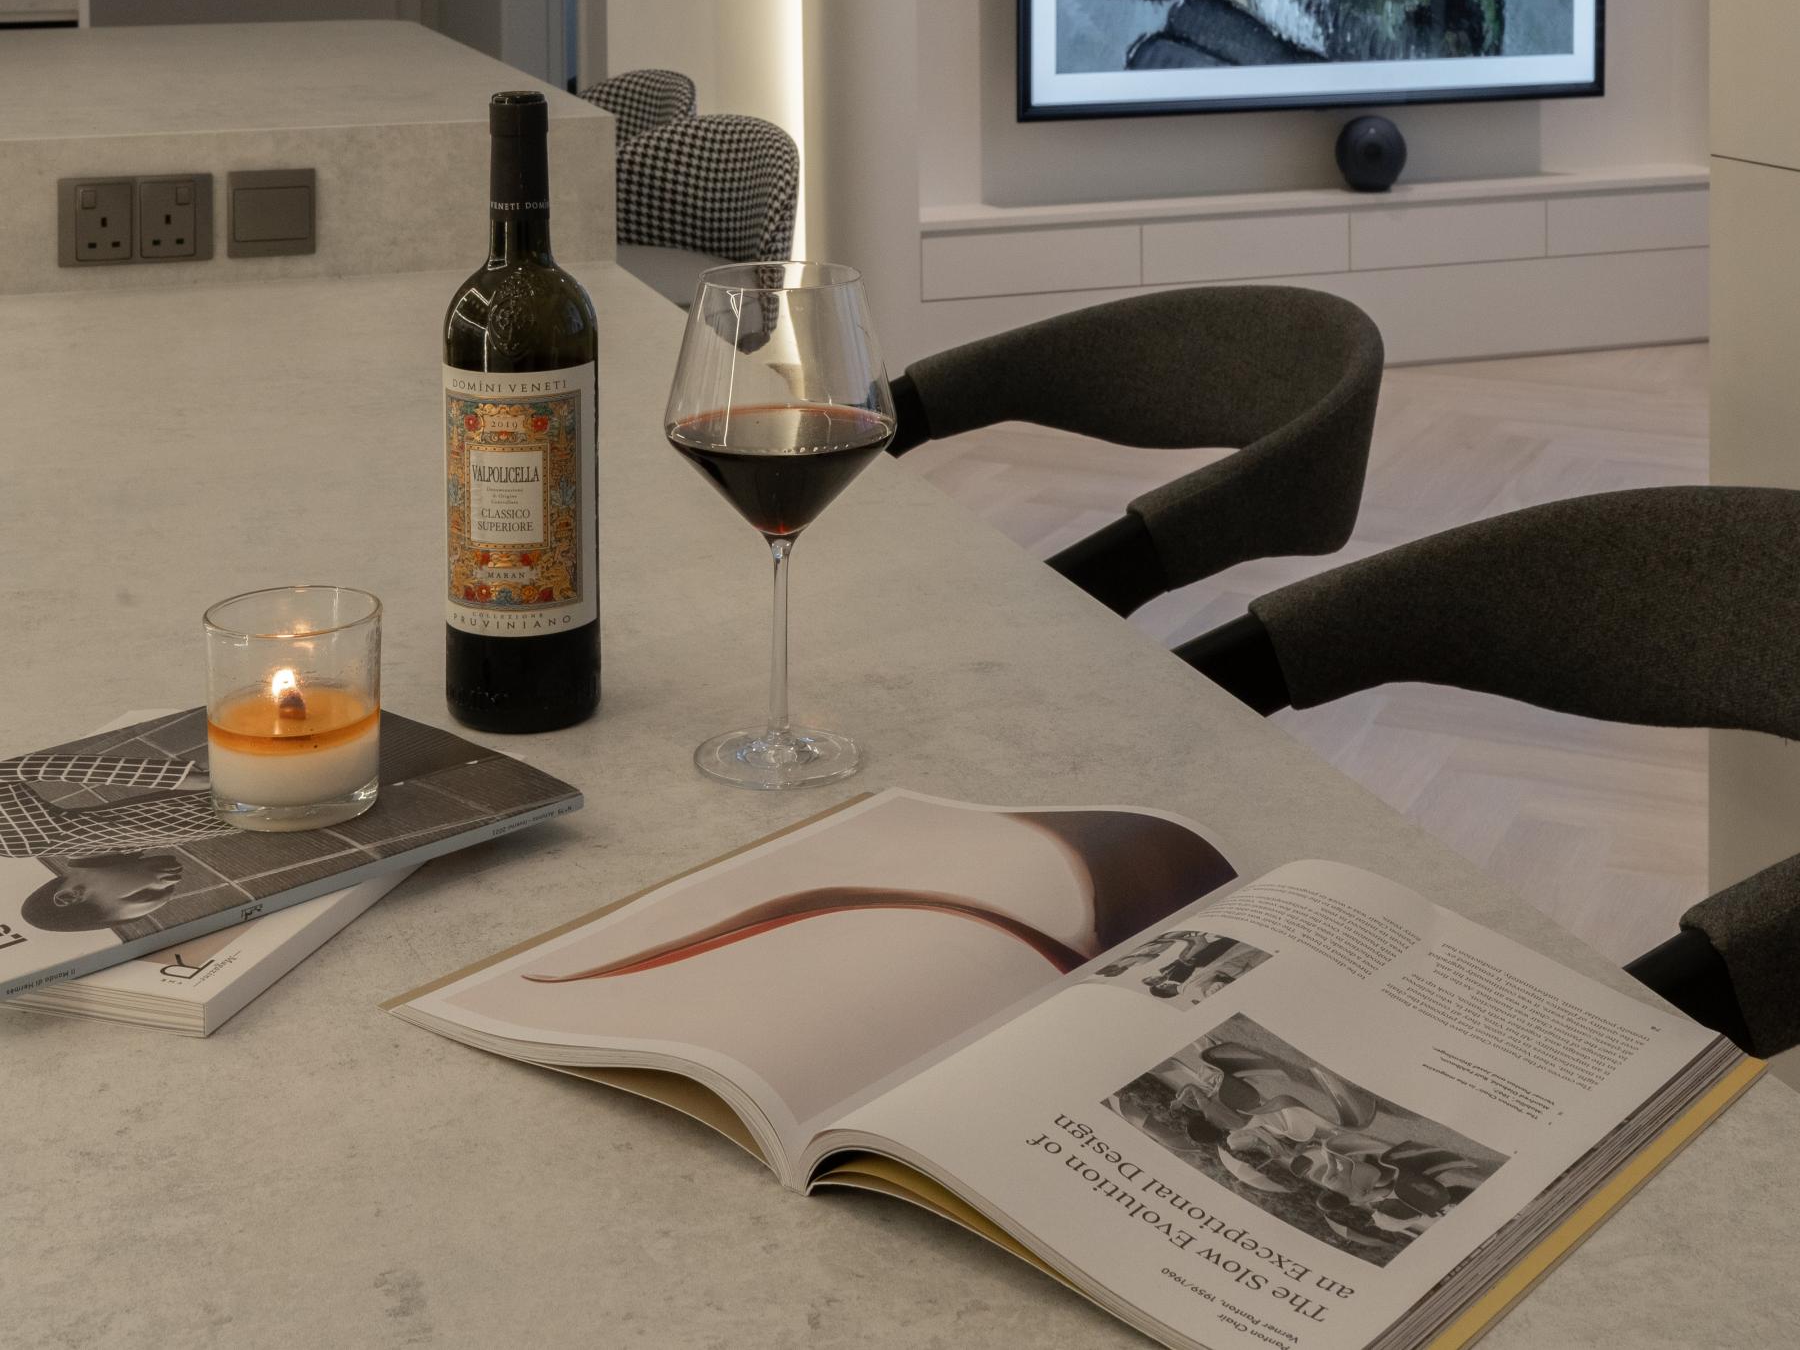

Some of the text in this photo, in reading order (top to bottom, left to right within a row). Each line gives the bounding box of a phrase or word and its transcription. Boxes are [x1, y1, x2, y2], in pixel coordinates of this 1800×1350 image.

[508, 379, 567, 393] VENETI
[491, 420, 518, 430] 2019
[472, 464, 540, 483] VALPOLICELLA
[481, 508, 531, 520] CLASSICO
[477, 521, 534, 532] SUPERIORE
[453, 613, 572, 630] PRUVINIANO
[1054, 1114, 1355, 1298] an Exceptional Design
[1026, 1134, 1326, 1322] The Slow Evolution of
[1161, 1267, 1217, 1303] 1959/1960
[1216, 1312, 1248, 1333] Chair
[1261, 1322, 1299, 1344] Verner
